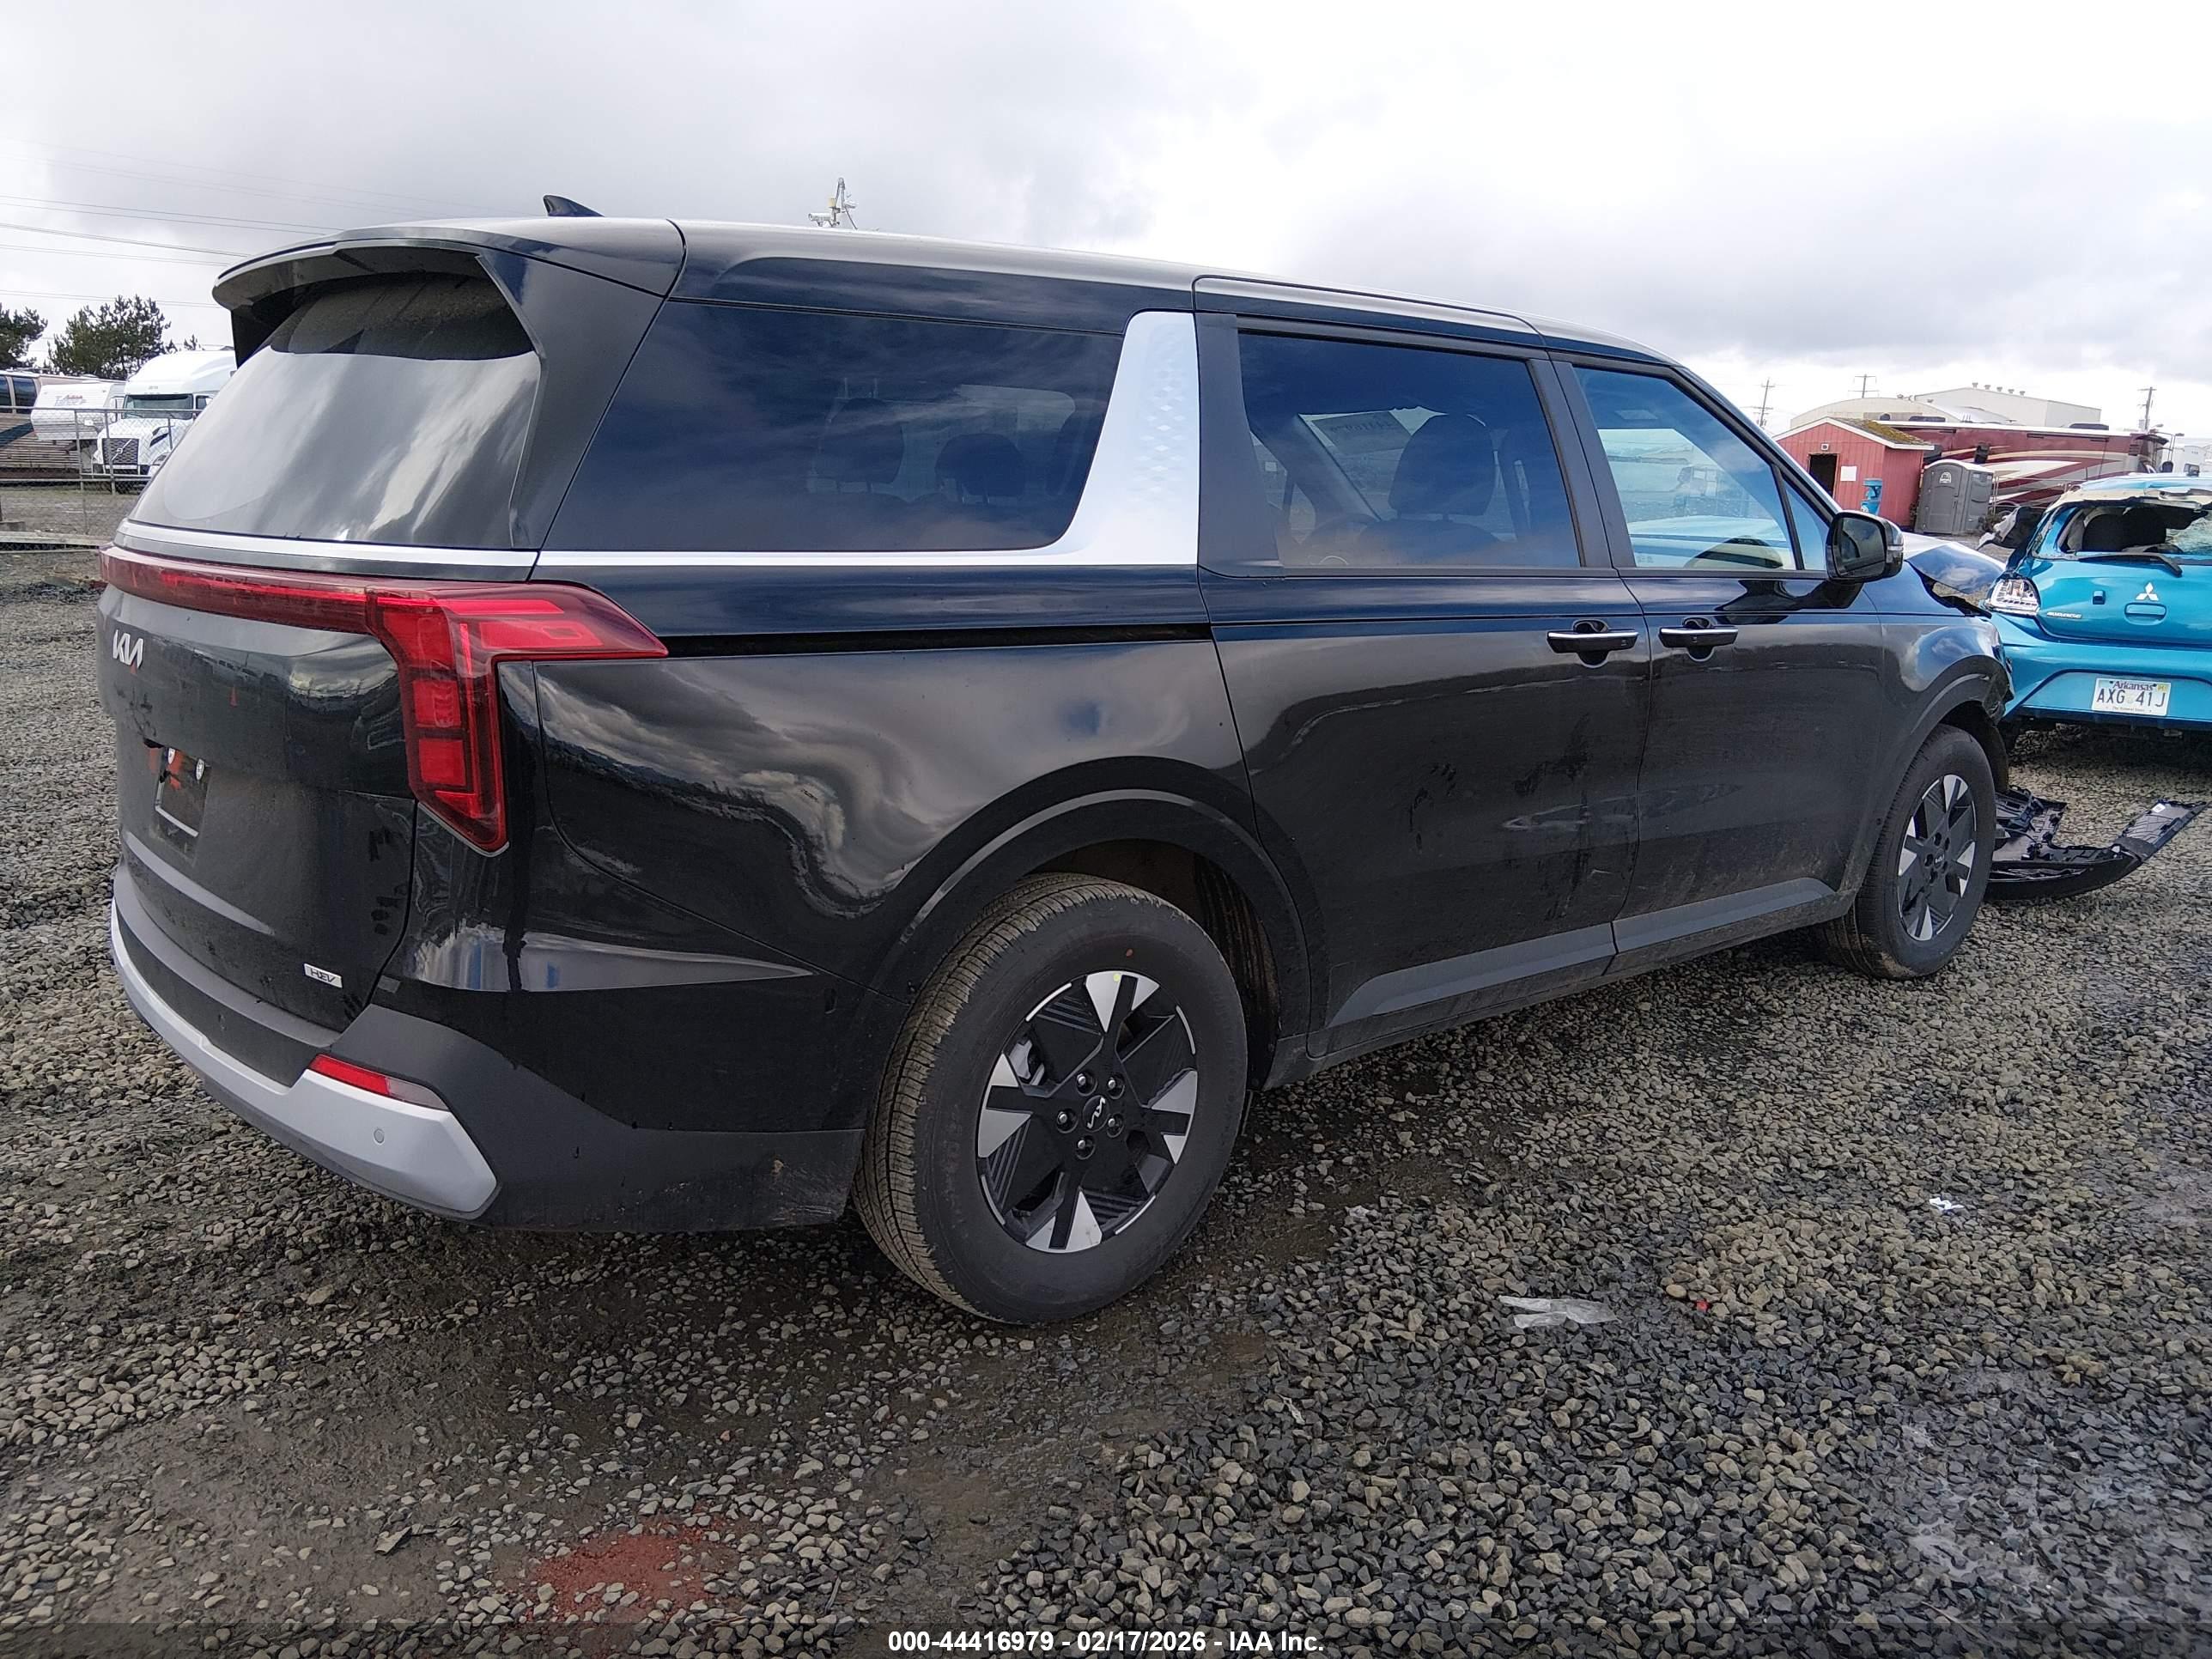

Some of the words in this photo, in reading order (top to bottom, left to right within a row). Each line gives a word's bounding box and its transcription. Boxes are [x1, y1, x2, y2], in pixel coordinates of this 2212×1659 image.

[2112, 680, 2154, 691] Arkansas
[2096, 689, 2125, 704] AXG
[2136, 691, 2166, 708] 41J
[310, 968, 336, 982] HEV
